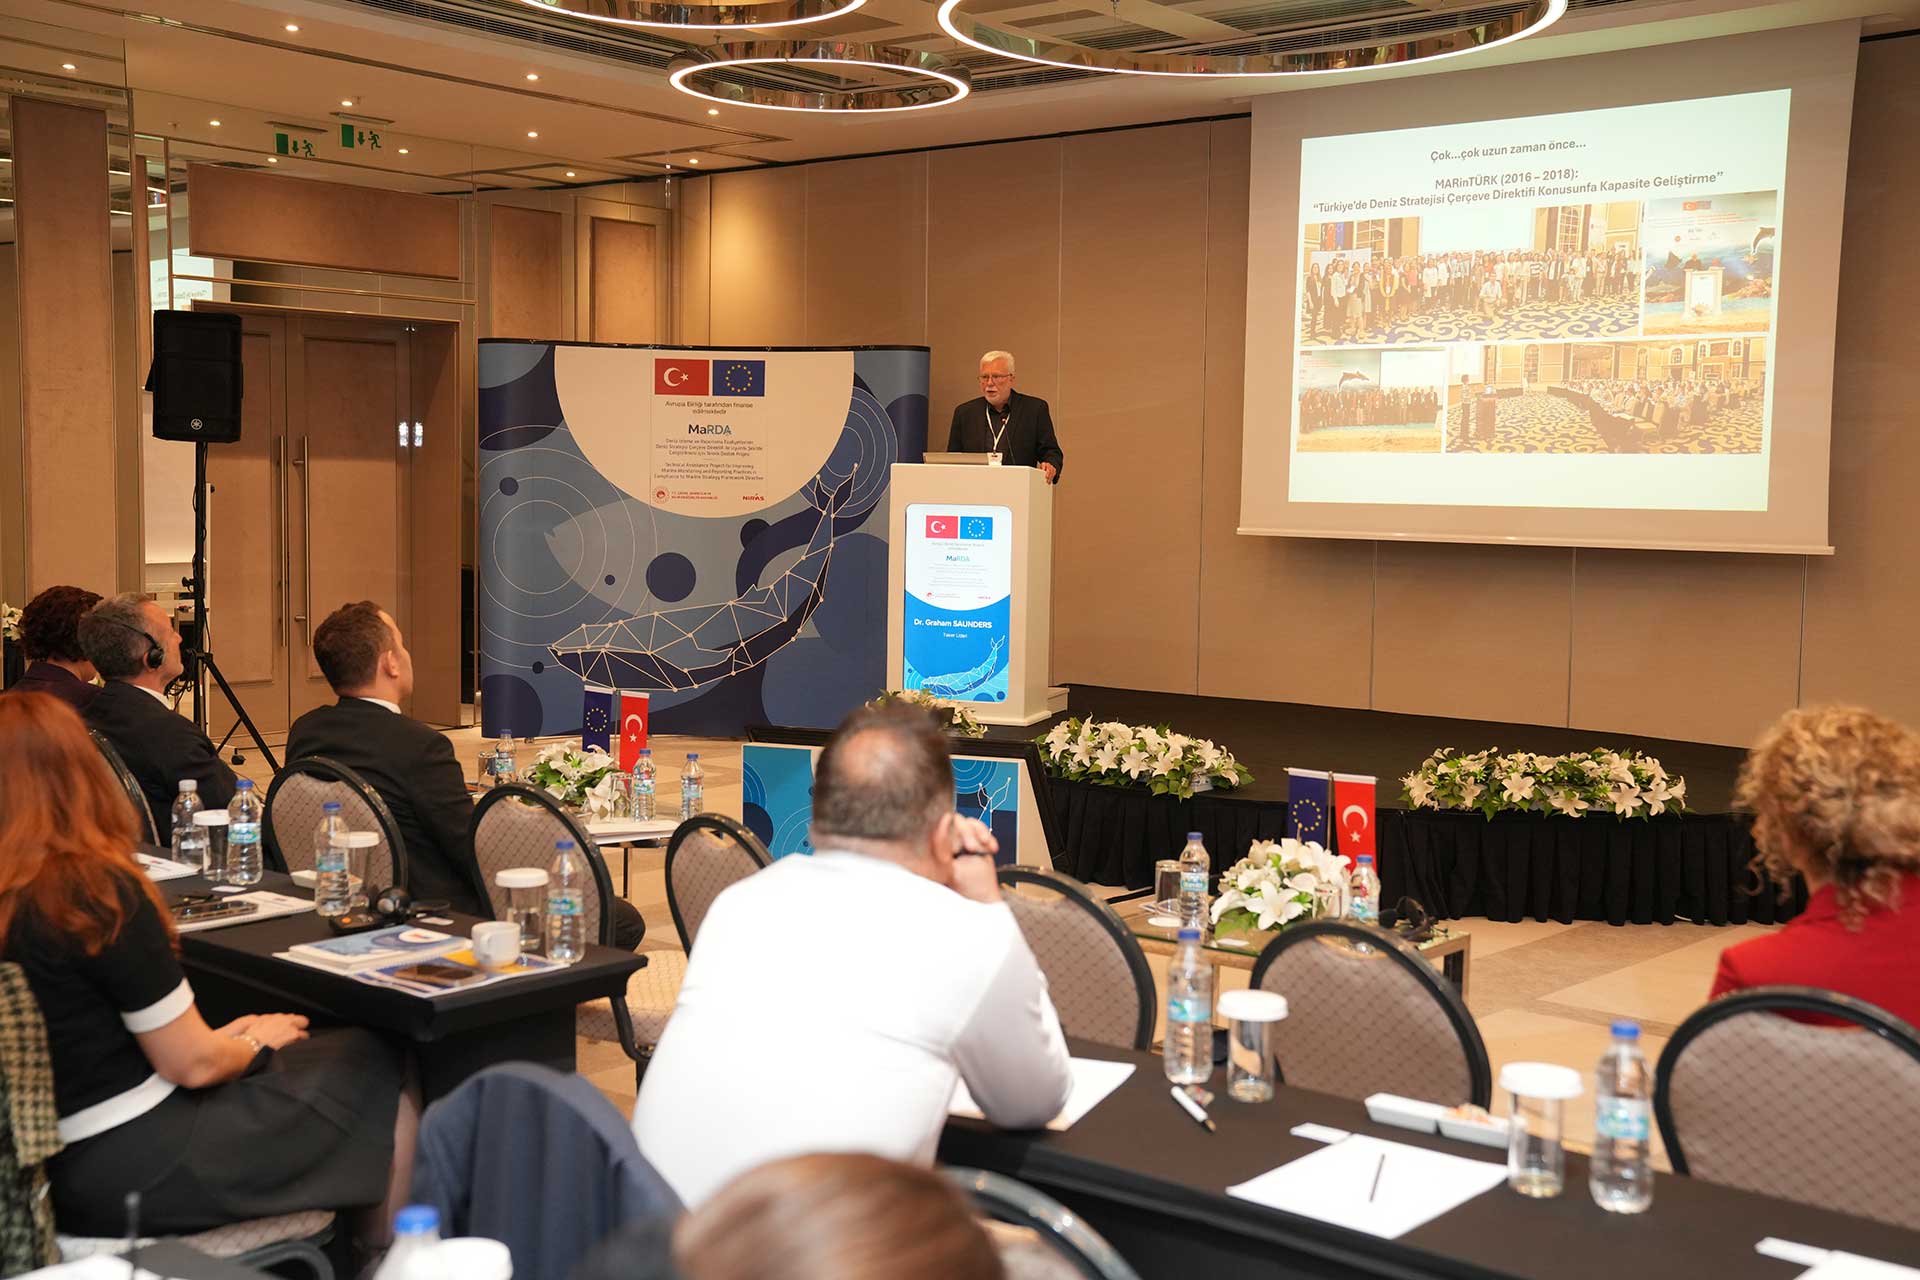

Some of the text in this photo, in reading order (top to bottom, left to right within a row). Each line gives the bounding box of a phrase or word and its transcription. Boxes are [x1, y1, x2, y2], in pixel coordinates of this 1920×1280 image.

[1482, 145, 1507, 157] uzun
[1510, 143, 1546, 154] zaman
[1549, 140, 1587, 151] önce...
[1435, 174, 1498, 189] MARinTÜRK
[1500, 172, 1532, 187] (2016
[1542, 168, 1579, 182] 2018):
[1369, 197, 1397, 209] Deniz
[1399, 191, 1445, 207] Stratejisi
[1447, 192, 1490, 206] Çerçeve
[1492, 187, 1536, 201] Direktifi
[1538, 182, 1597, 197] Konusunfa
[1600, 178, 1650, 193] Kapasite
[688, 424, 732, 436] MaRDA
[913, 618, 993, 629] Dr. Graham SAUNDERS
